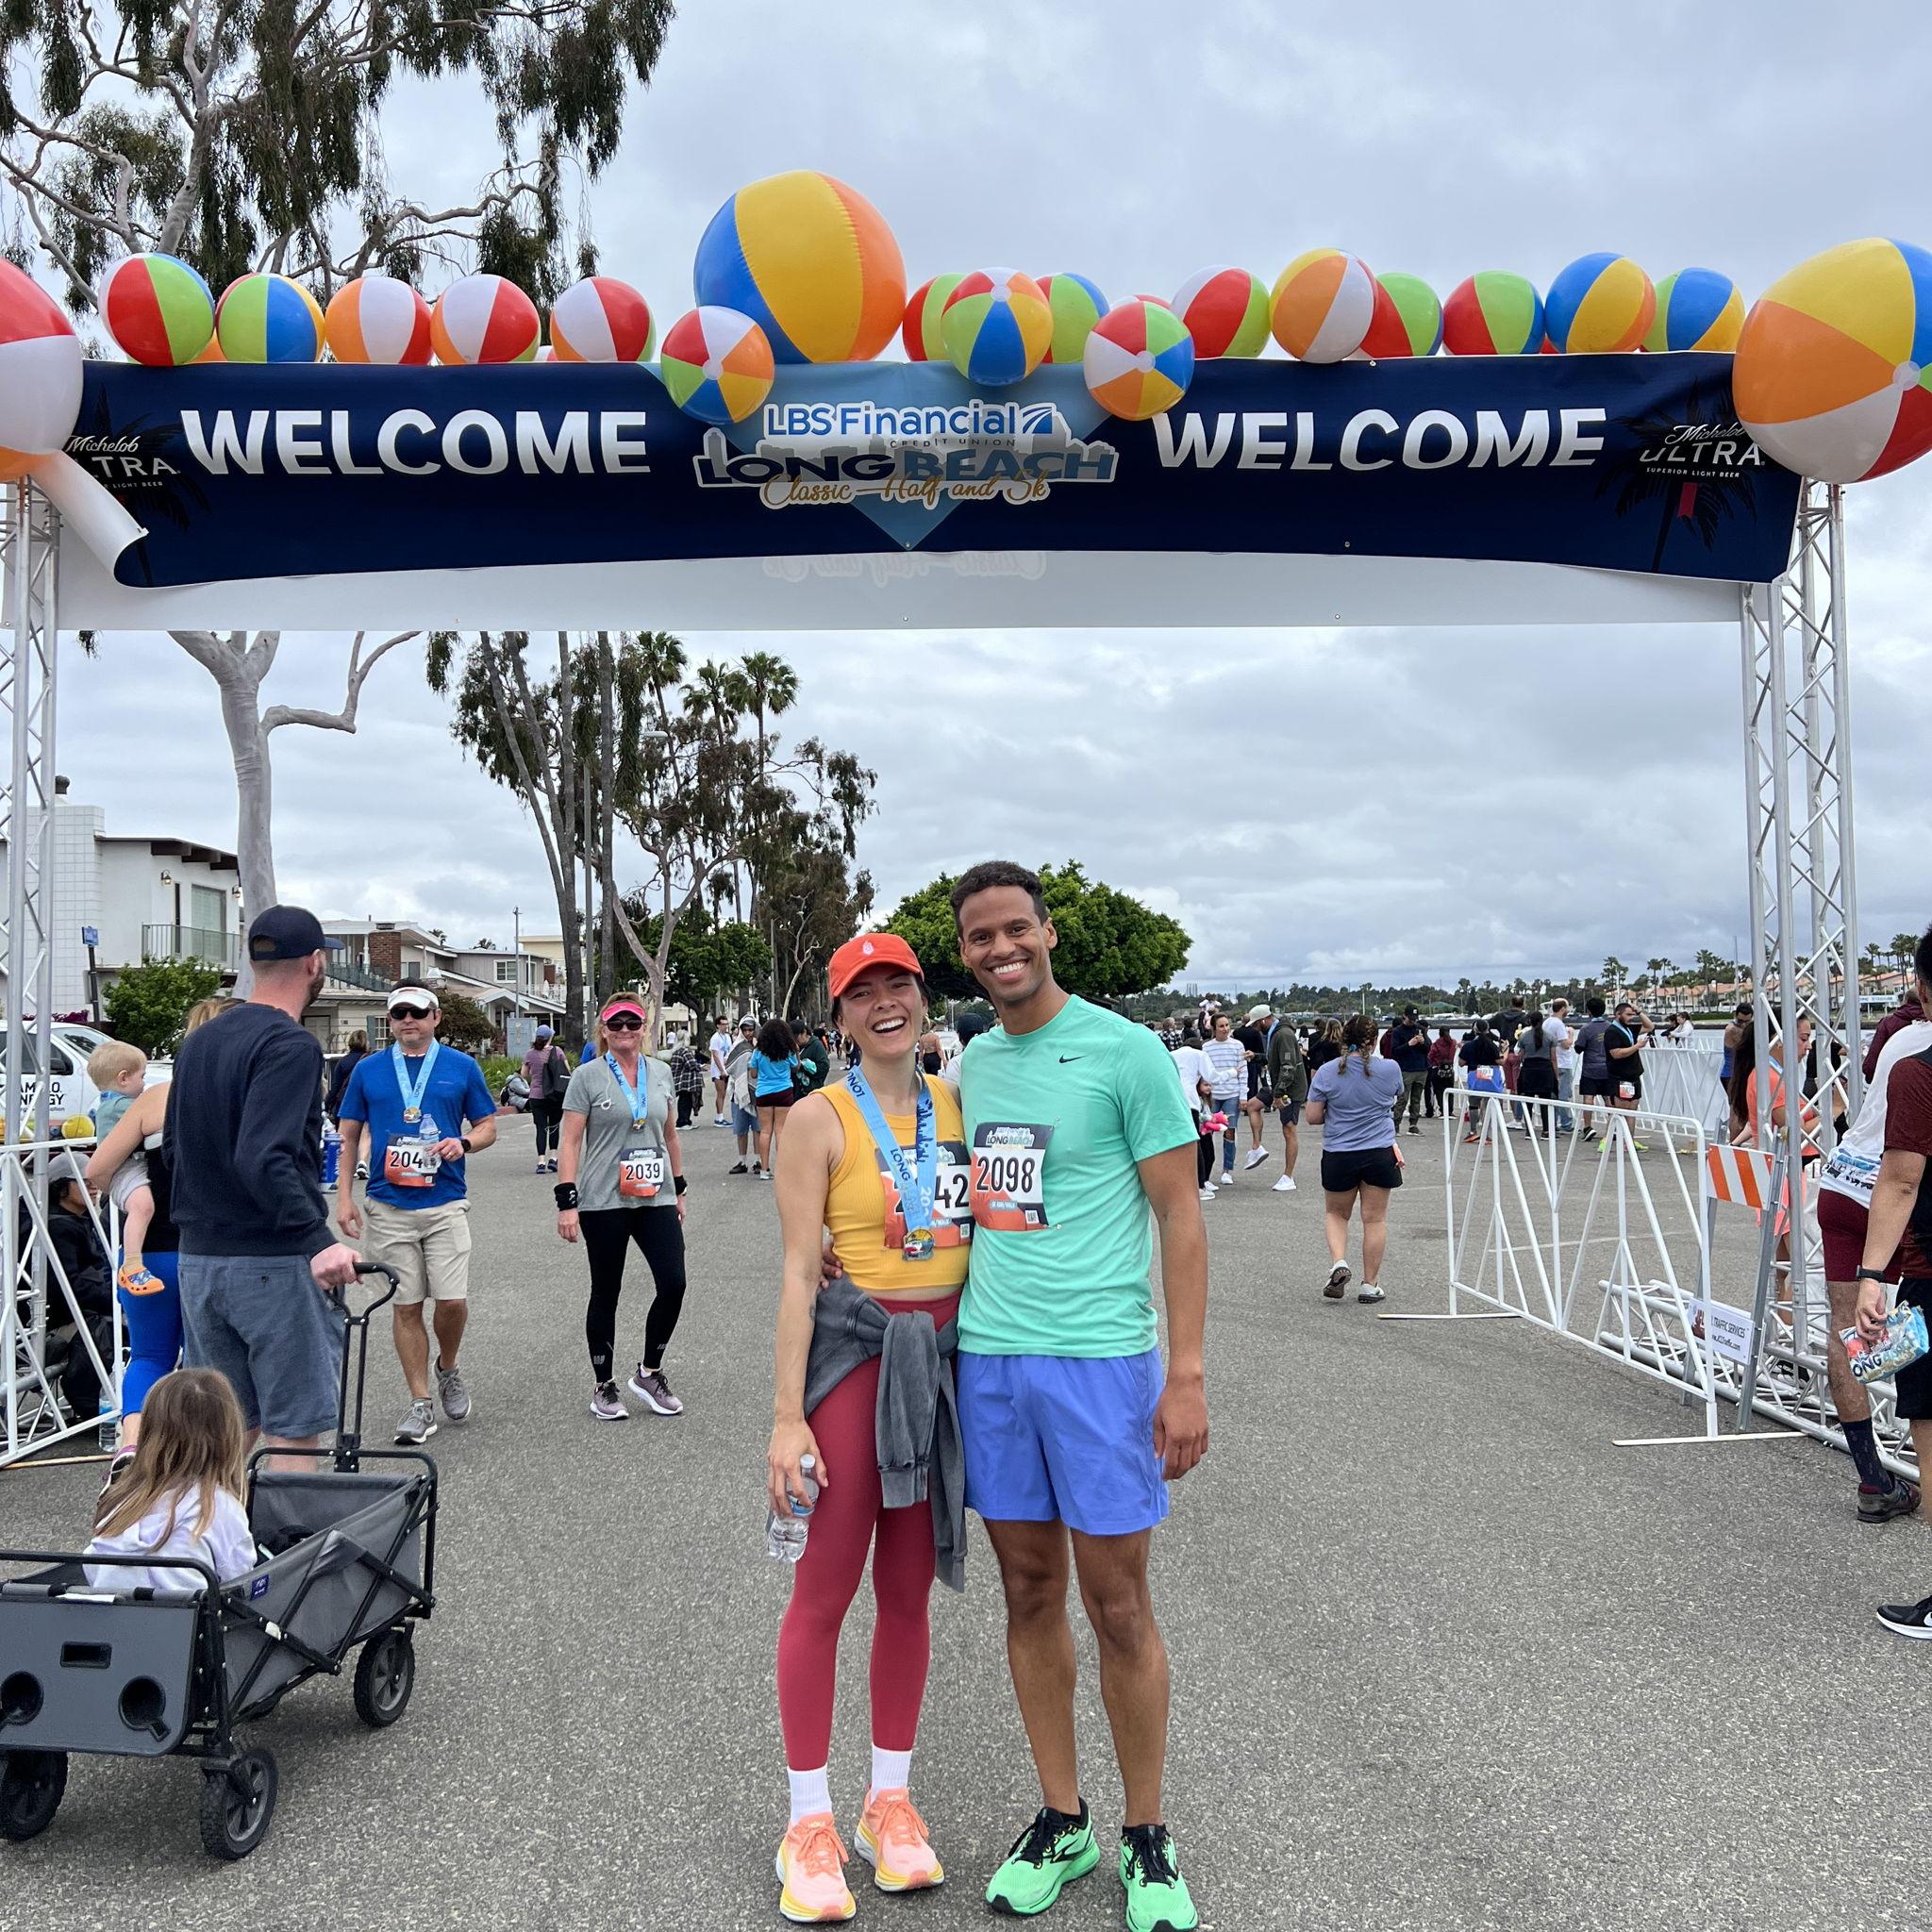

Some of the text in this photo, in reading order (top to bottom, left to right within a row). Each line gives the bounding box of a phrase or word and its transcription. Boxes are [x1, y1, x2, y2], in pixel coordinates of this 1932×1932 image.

[767, 402, 1016, 436] LBS Financial
[65, 435, 142, 453] Michelob
[180, 408, 651, 474] WELCOME
[890, 437, 1016, 449] CREDIT UNION
[1152, 408, 1607, 471] WELCOME
[1639, 441, 1761, 466] ULTRA
[91, 456, 178, 478] TRA
[698, 449, 1115, 482] LONG BEACH
[1646, 467, 1688, 475] SUPERIOR
[763, 474, 853, 506] Classic
[858, 472, 942, 507] Half
[951, 475, 998, 498] and
[625, 1162, 660, 1181] 2039
[890, 1148, 911, 1182] LONG
[976, 1156, 1036, 1193] 2098
